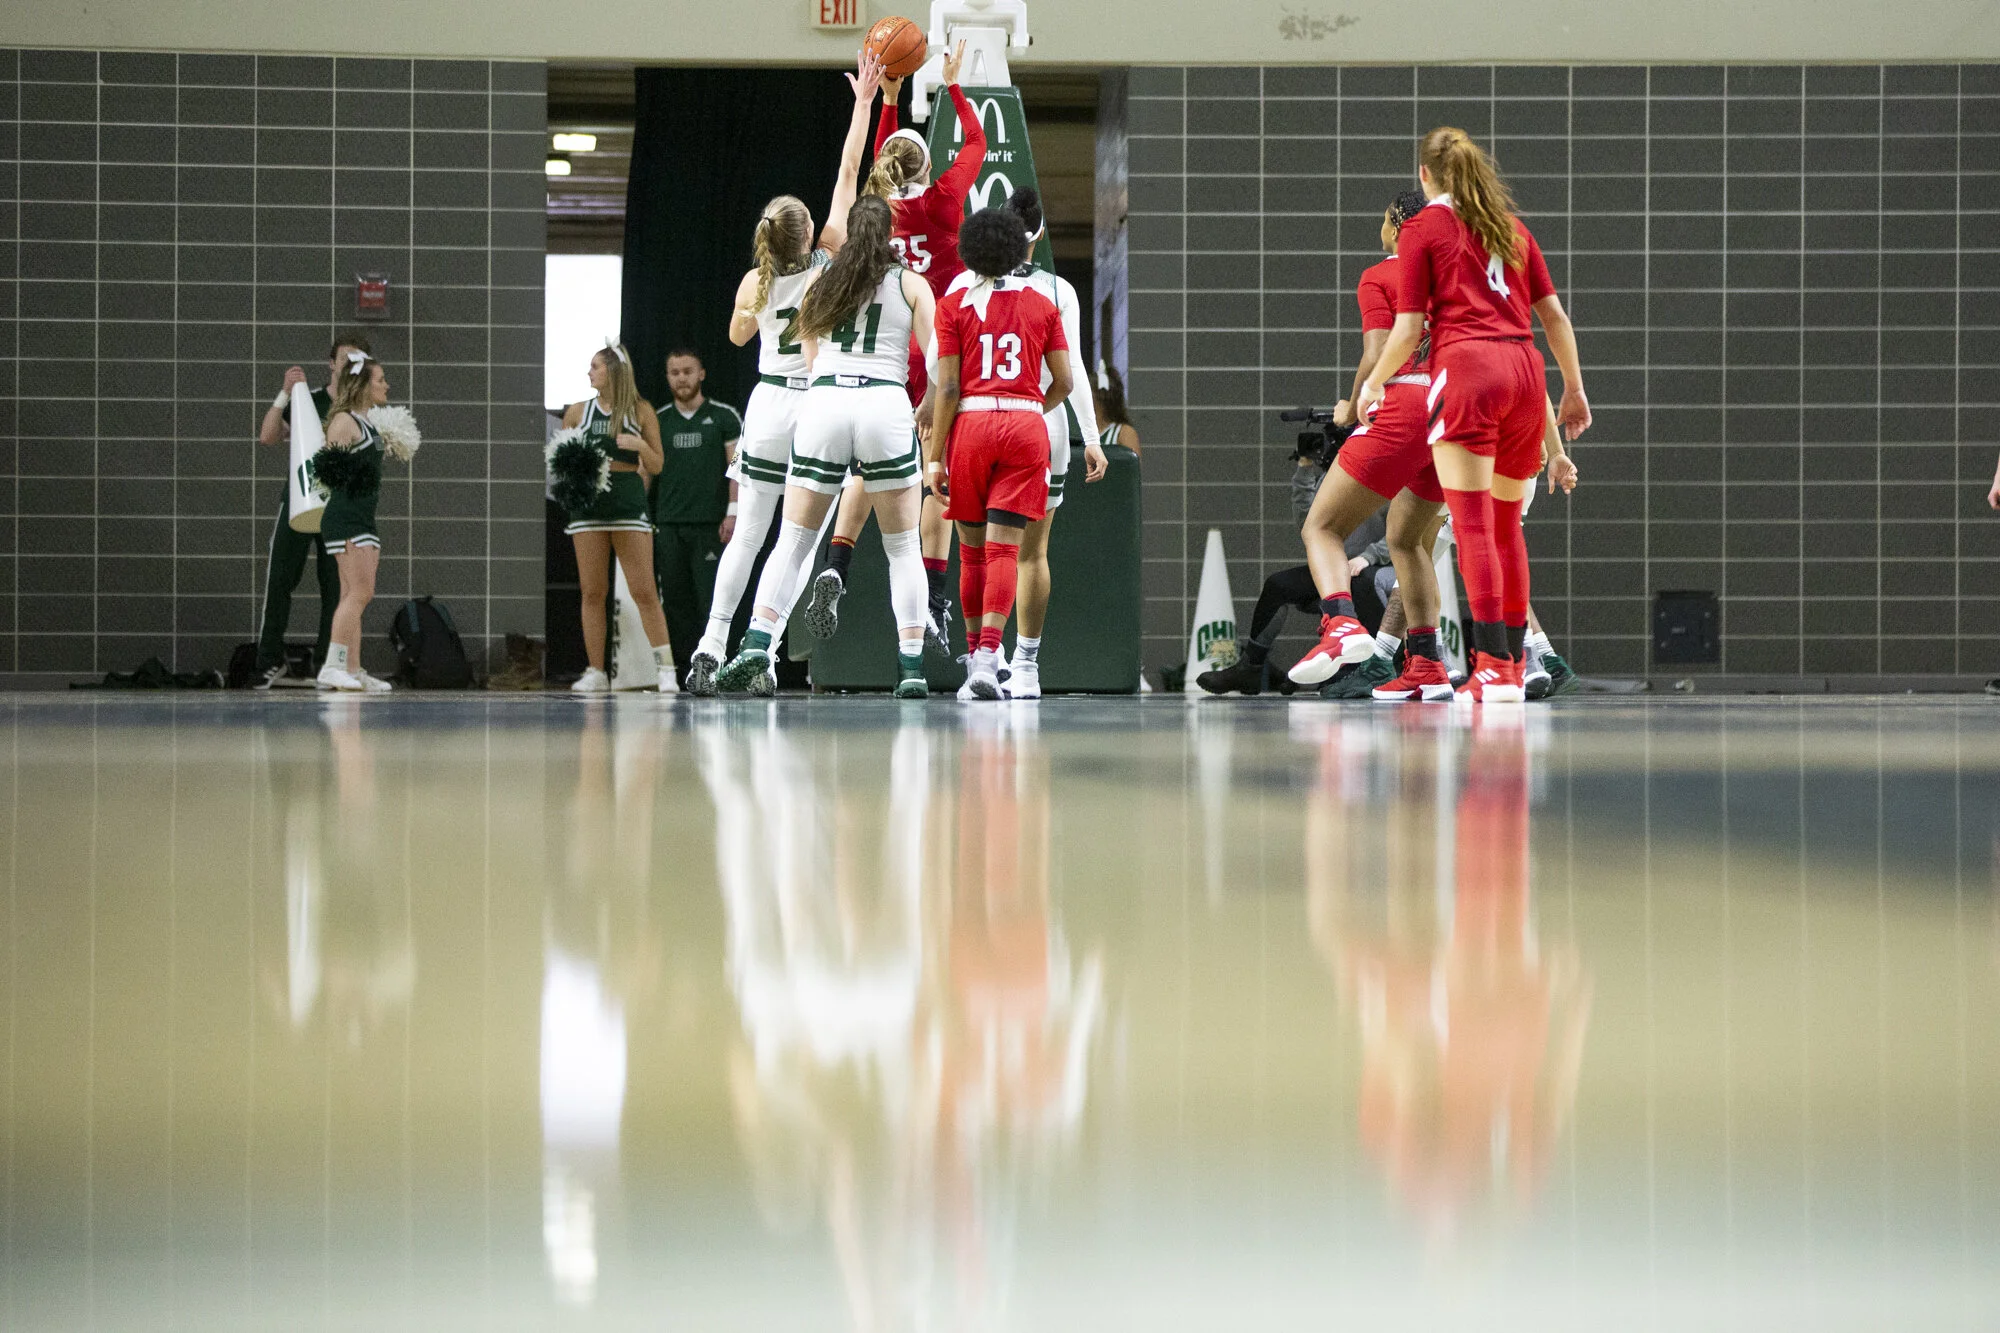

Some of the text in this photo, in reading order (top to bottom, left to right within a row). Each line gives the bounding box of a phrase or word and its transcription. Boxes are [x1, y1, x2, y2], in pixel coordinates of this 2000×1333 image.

[820, 0, 857, 24] EXIT
[1485, 252, 1511, 301] 4
[831, 303, 883, 354] 41
[978, 332, 1022, 380] 13
